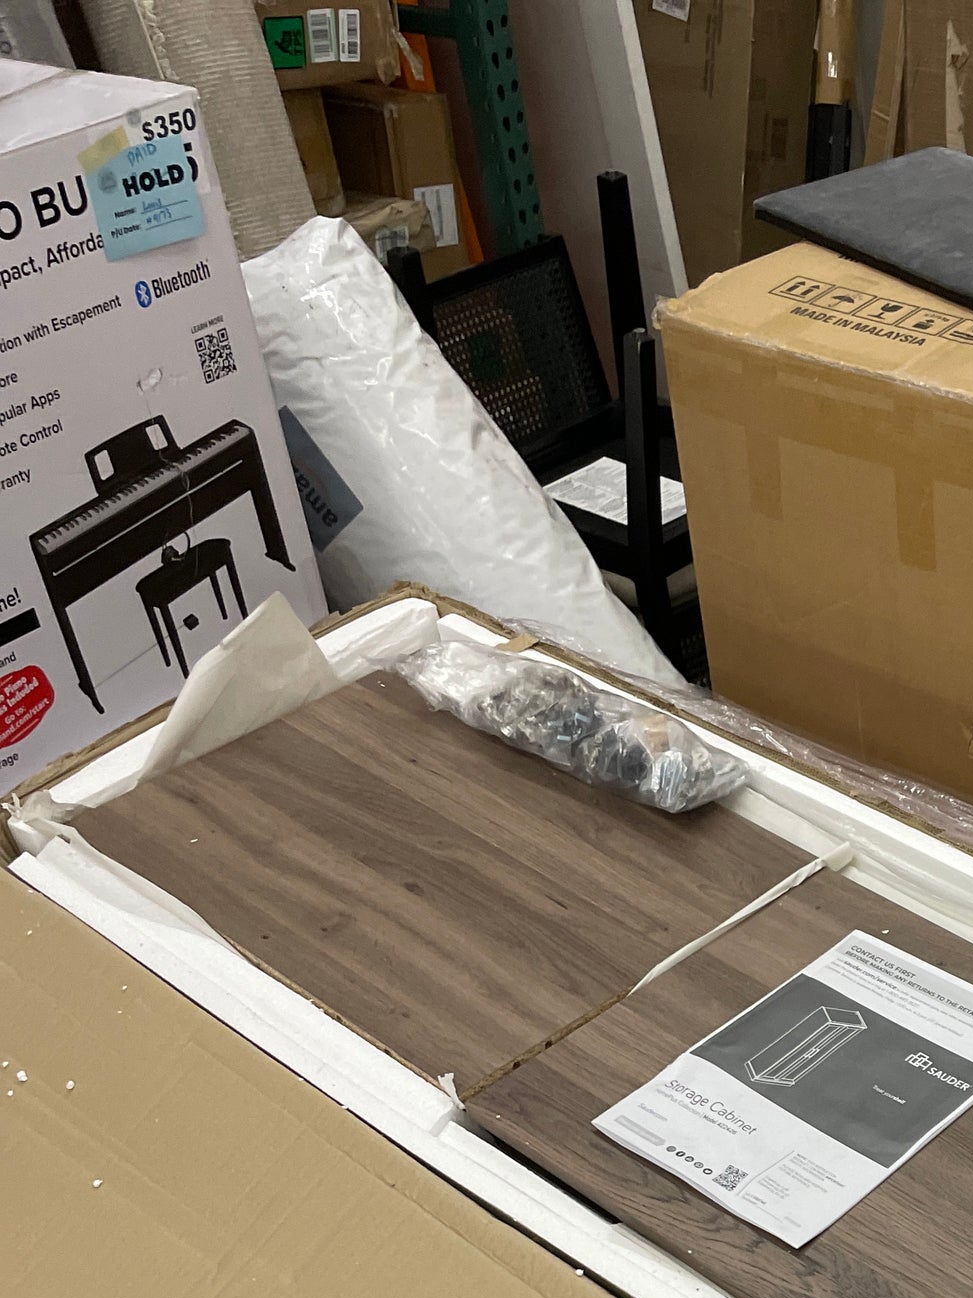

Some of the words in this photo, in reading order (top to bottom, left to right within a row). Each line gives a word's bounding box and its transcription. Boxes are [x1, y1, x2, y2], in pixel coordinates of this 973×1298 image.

[142, 107, 196, 142] $350
[121, 163, 185, 199] HOLD
[151, 260, 211, 300] Bluetooth
[23, 322, 50, 346] with
[51, 294, 122, 333] Escapement
[790, 306, 835, 324] MADE
[833, 318, 851, 328] IN
[851, 323, 926, 347] MALAYSIA
[30, 387, 61, 413] Apps
[20, 419, 63, 449] Control
[4, 676, 28, 696] Piano
[4, 711, 16, 726] Go
[845, 951, 870, 965] BEFORE
[870, 963, 894, 977] MAKING
[893, 974, 908, 984] ANY
[907, 981, 936, 997] RETURNS
[945, 999, 959, 1008] THE
[850, 945, 885, 964] CONTACT
[883, 961, 896, 970] US
[895, 967, 916, 979] FIRST
[927, 1066, 970, 1092] SAUDER
[664, 1078, 709, 1107] Storage
[708, 1101, 758, 1136] Cabinet
